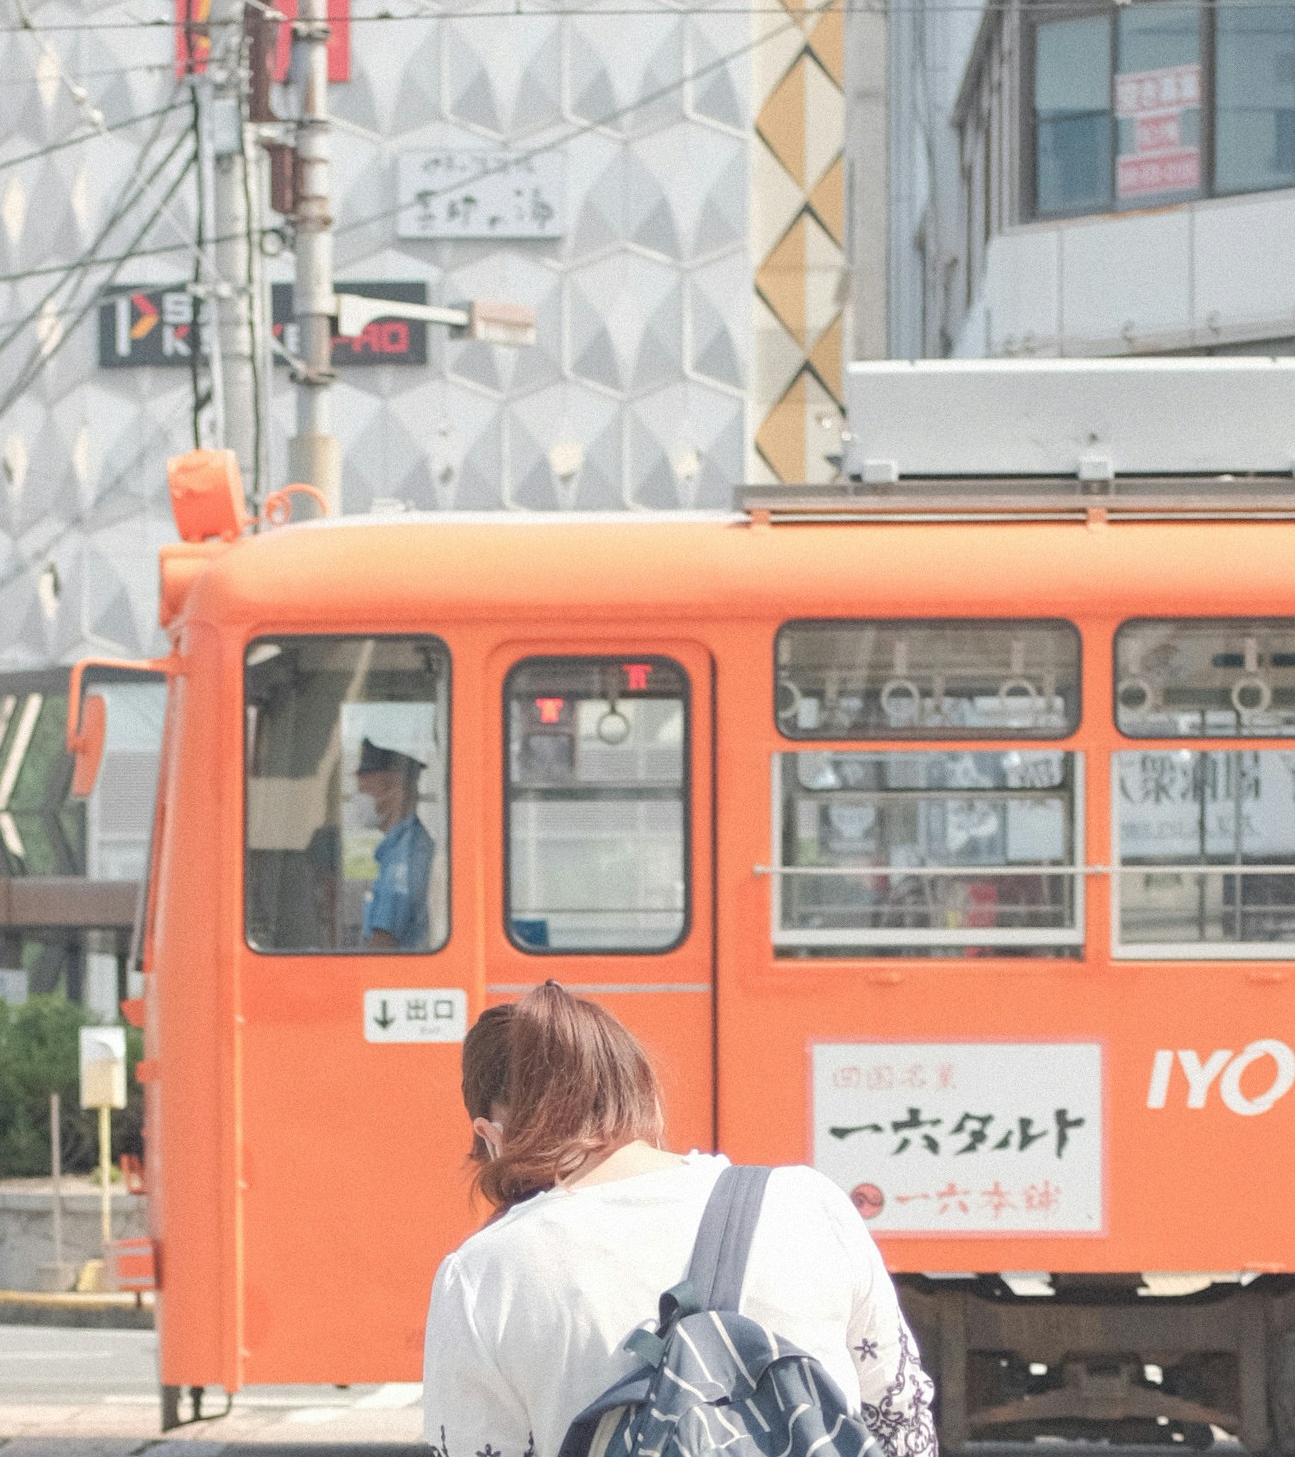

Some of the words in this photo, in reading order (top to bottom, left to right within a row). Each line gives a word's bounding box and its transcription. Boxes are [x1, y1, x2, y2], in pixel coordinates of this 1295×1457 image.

[406, 998, 454, 1021] 出口
[828, 1107, 1086, 1159] 一六タルト
[894, 1178, 1061, 1219] 一六本舗
